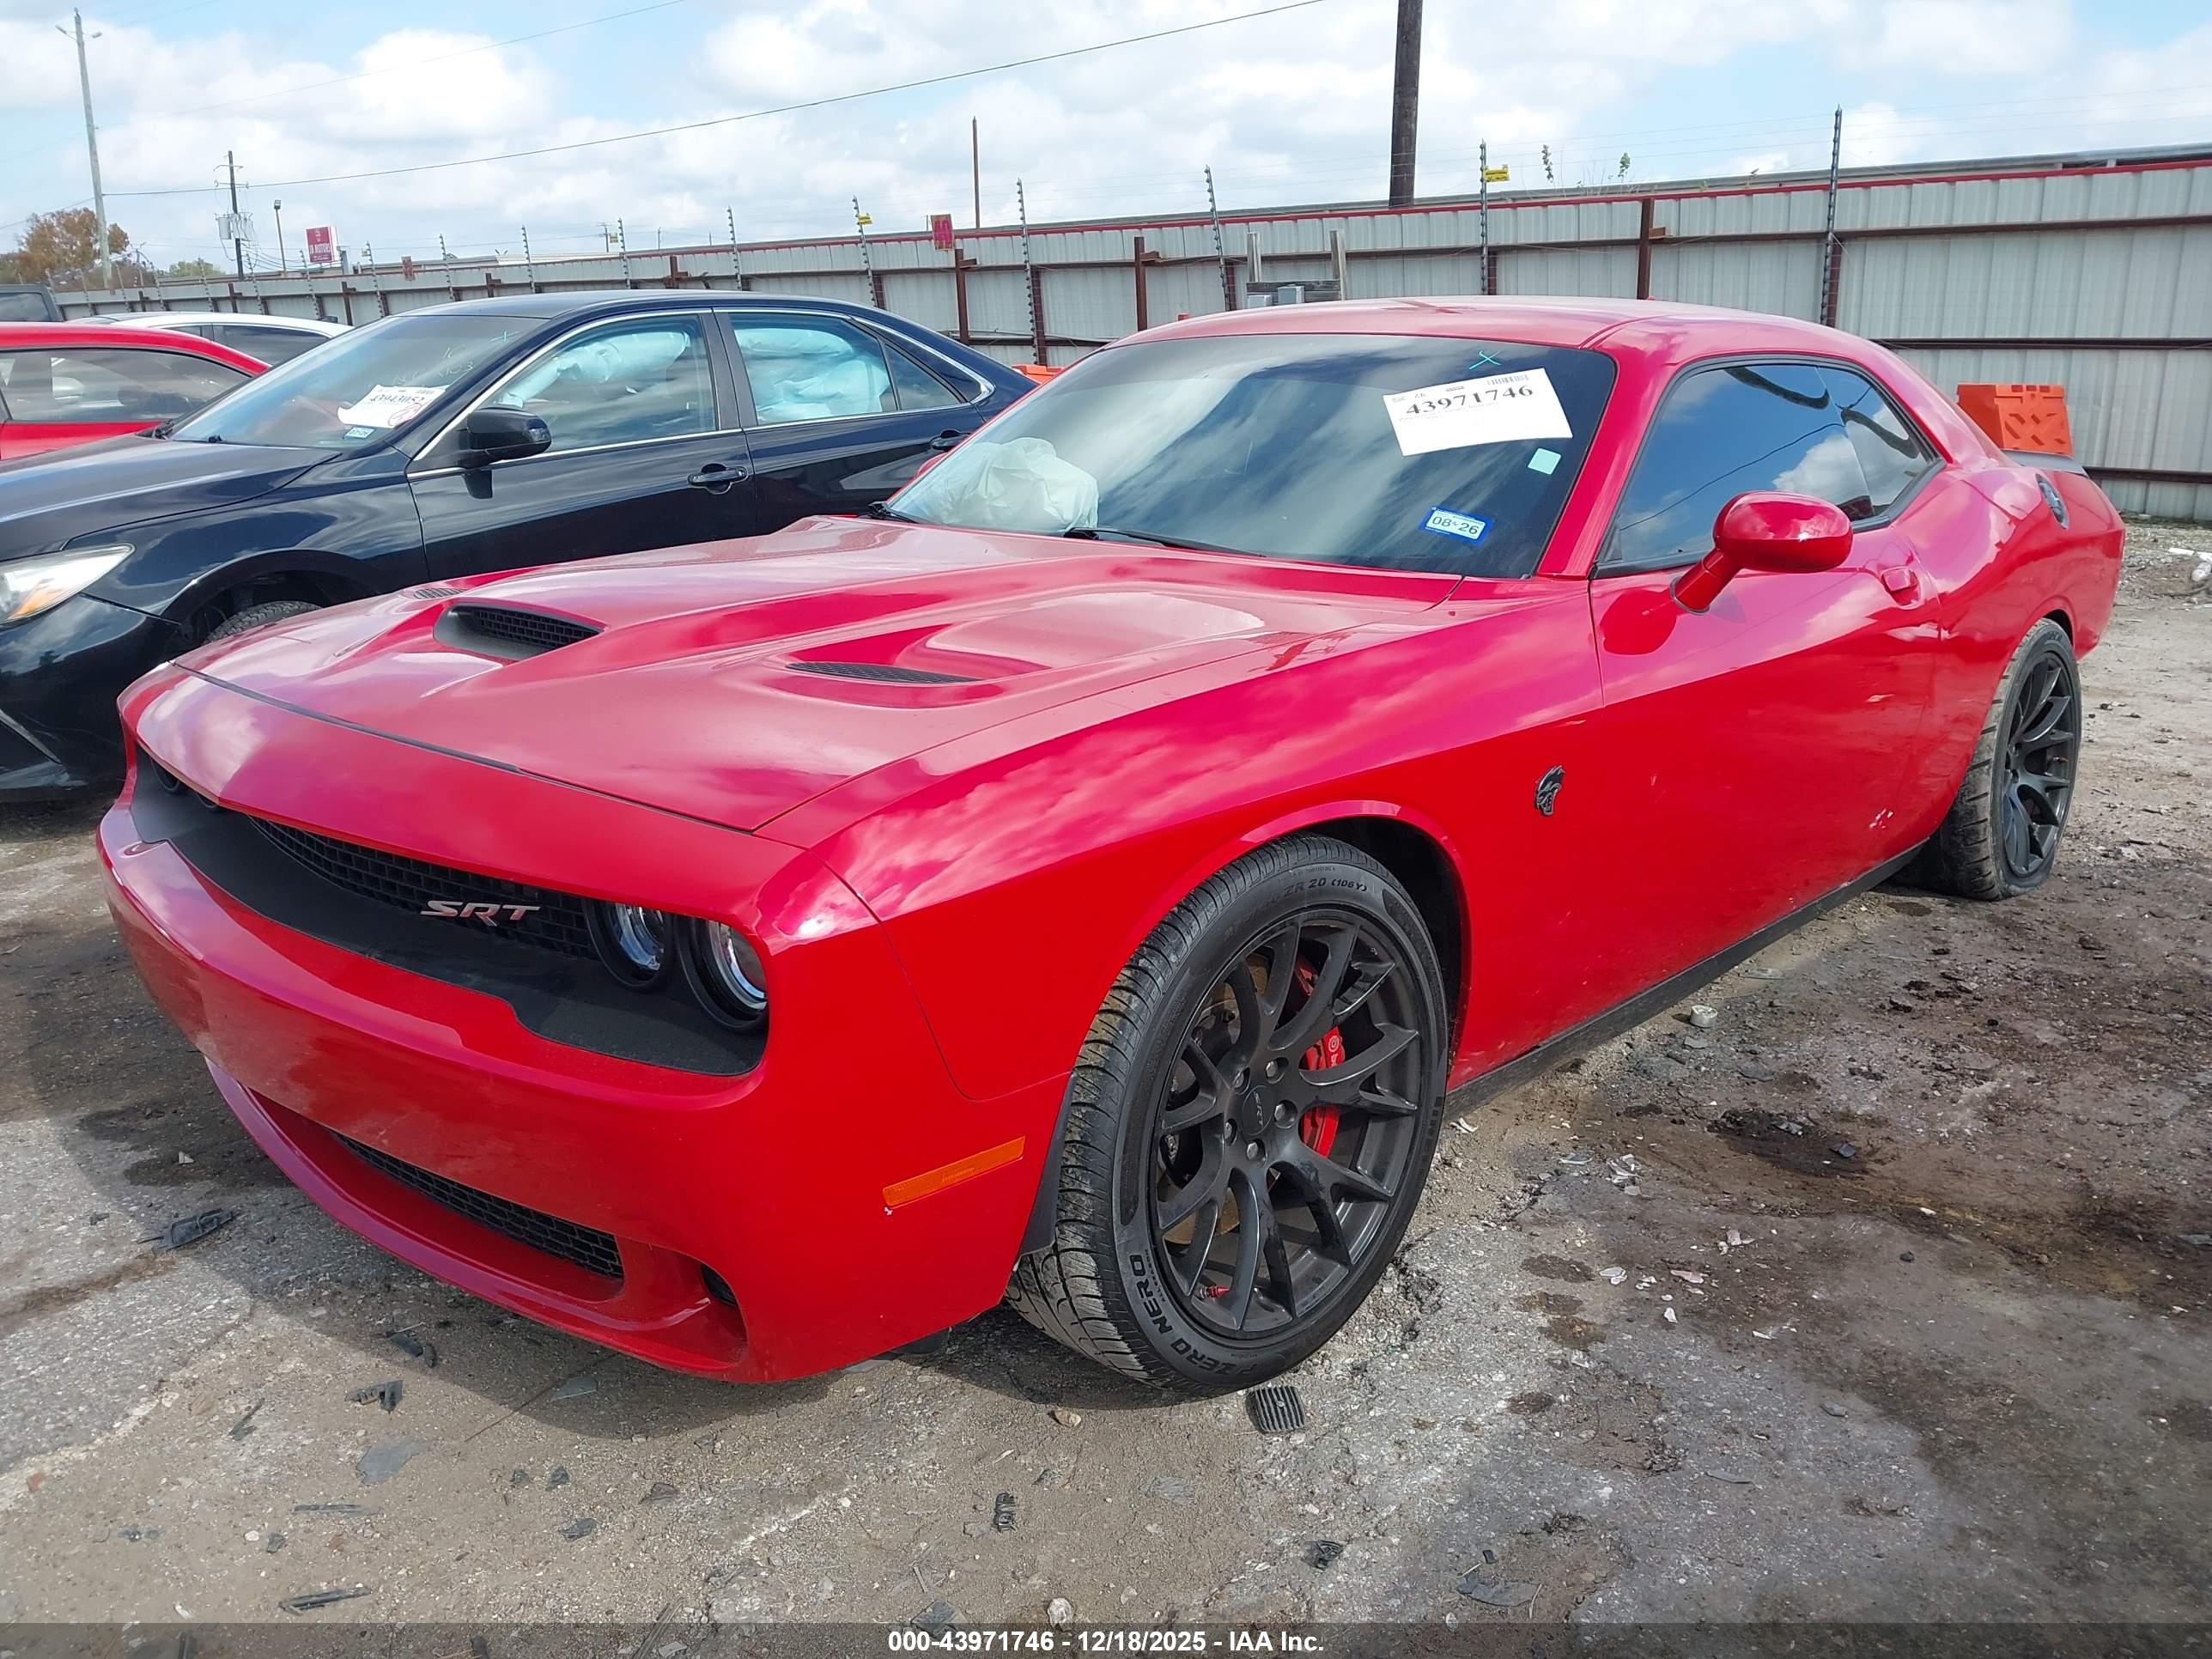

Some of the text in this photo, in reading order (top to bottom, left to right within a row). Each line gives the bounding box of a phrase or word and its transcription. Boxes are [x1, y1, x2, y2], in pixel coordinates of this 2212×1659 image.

[1406, 385, 1534, 414] 43971746
[1308, 878, 1327, 889] 20
[420, 900, 541, 927] SRT
[1129, 1255, 1173, 1334] NERO
[1170, 1337, 1237, 1376] ZERO
